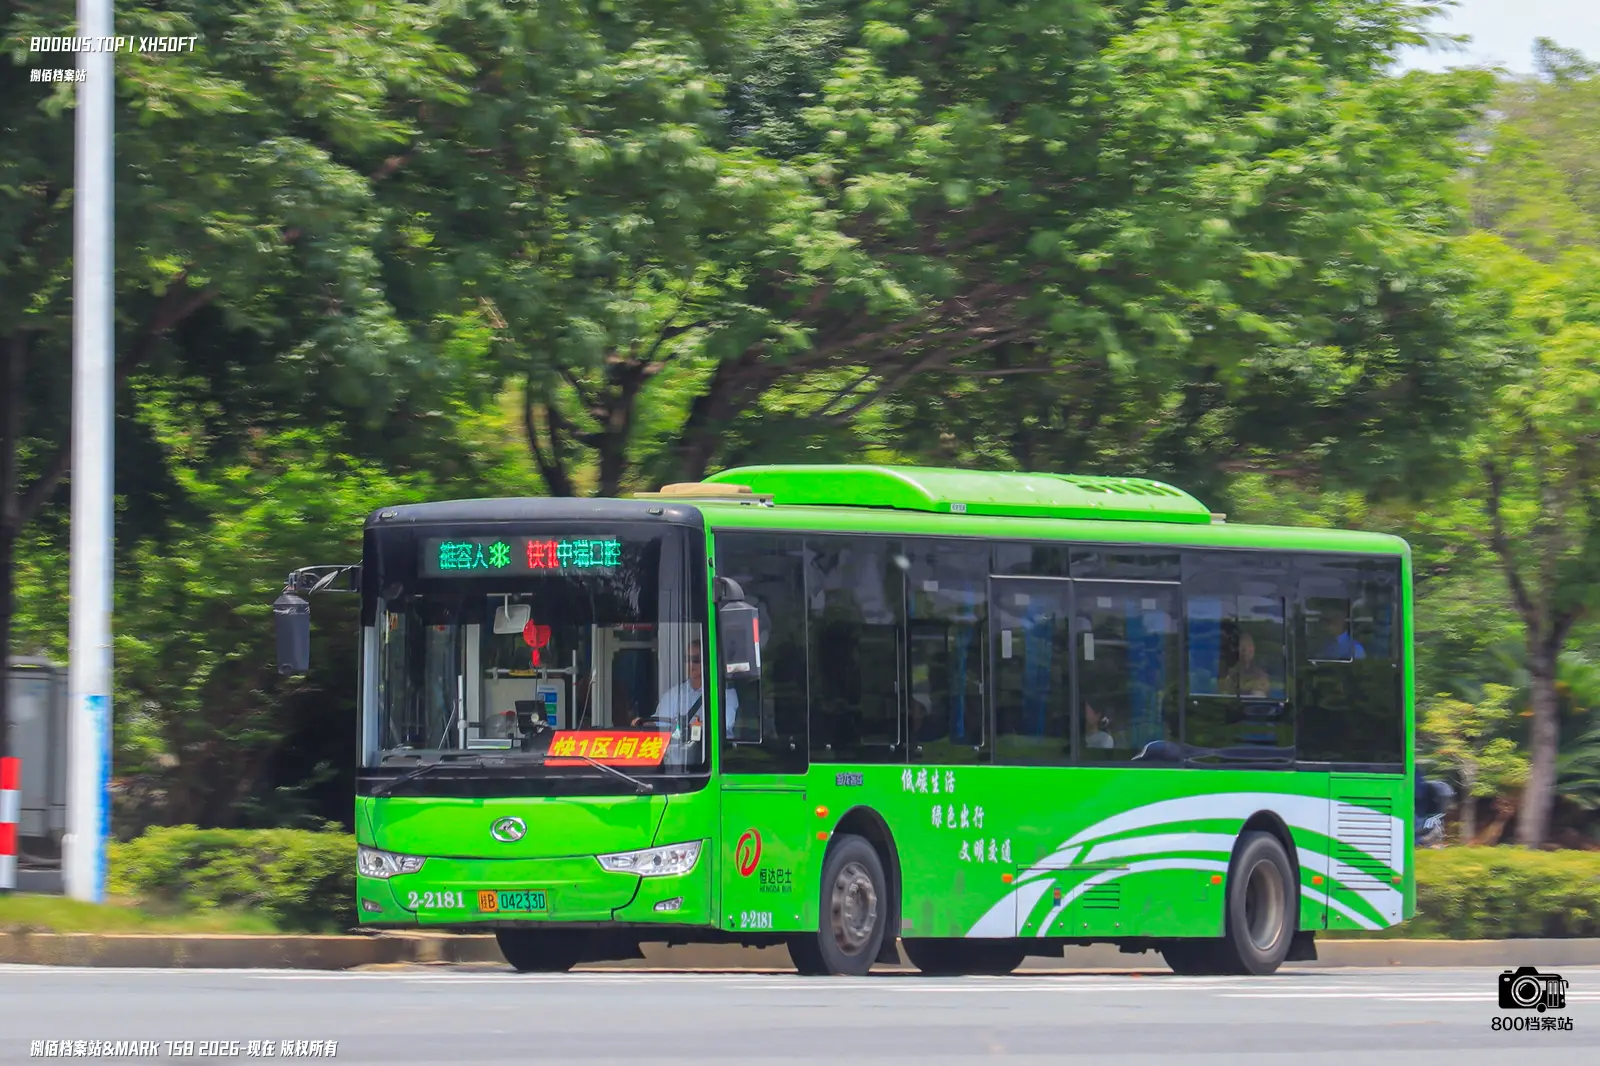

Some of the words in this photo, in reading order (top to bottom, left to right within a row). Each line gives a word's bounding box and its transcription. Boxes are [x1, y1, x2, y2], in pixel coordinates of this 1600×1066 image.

[553, 735, 663, 759] 快1区间线
[901, 768, 956, 793] 低碳生活
[931, 804, 984, 828] 绿色出行
[760, 868, 792, 884] 恒达巴士
[408, 891, 465, 909] 2-2181
[740, 911, 773, 929] 2-2181
